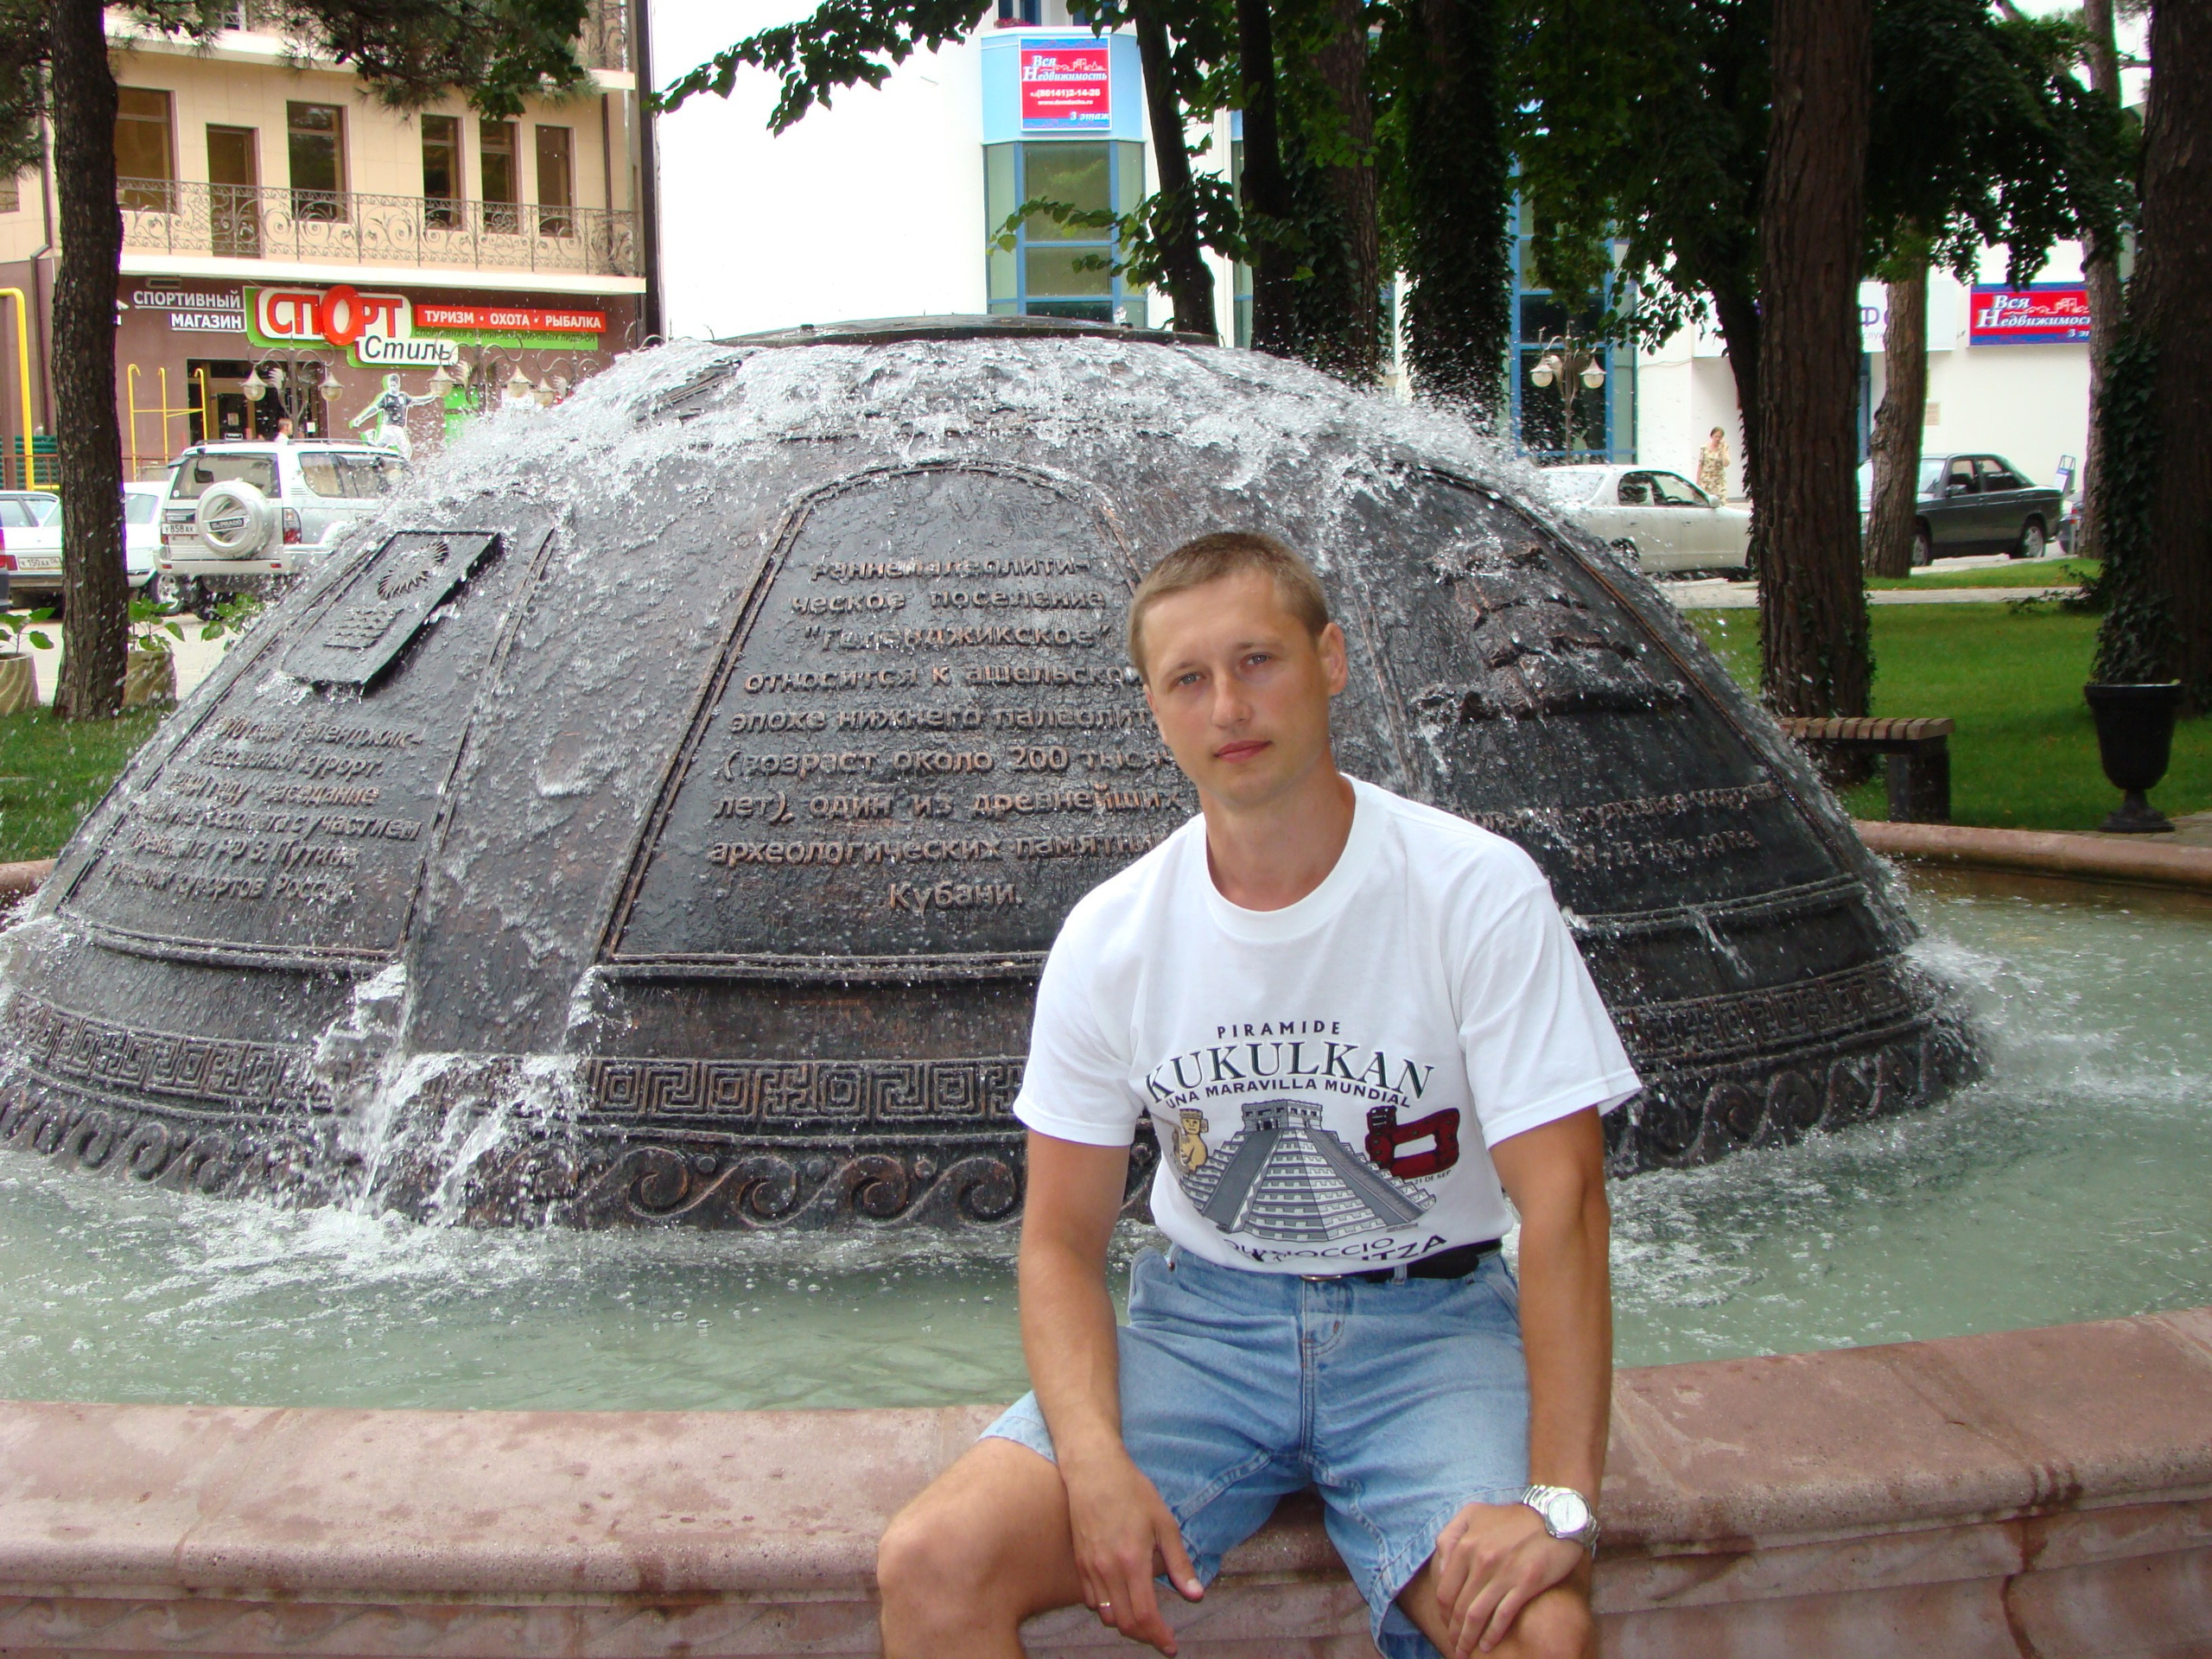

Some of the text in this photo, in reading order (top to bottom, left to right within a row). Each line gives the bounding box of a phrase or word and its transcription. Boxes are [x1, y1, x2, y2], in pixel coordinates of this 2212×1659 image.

[1032, 54, 1057, 67] Вся
[1022, 66, 1108, 81] Недвижимость
[1070, 111, 1109, 121] 3 этаж
[133, 289, 240, 308] СПОРТИВНЫЙ
[1993, 295, 2031, 309] Вся
[171, 313, 242, 329] МАГАЗИН
[266, 284, 404, 346] СПОРТ
[424, 309, 602, 328] ТУРИЗМ ОХОТА РЫБАЛКА
[2068, 328, 2076, 339] 3
[365, 335, 453, 360] Стиль
[810, 557, 1090, 582] раннепалеолити-
[790, 589, 1108, 615] ческое поселение
[745, 669, 918, 693] относится
[932, 665, 950, 685] к
[730, 709, 828, 733] эпохе
[836, 707, 984, 732] нижнего
[722, 750, 879, 779] (возраст
[893, 750, 995, 773] около
[1011, 746, 1071, 772] 200
[261, 785, 379, 806] заседание
[809, 793, 893, 822] один
[912, 792, 951, 817] из
[970, 783, 1182, 817] древнейших
[304, 815, 423, 841] участием
[709, 836, 1003, 868] археологических
[1217, 1020, 1341, 1039] PIRAMIDE
[1146, 1040, 1436, 1104] KUKULKAN
[1166, 1077, 1412, 1110] UNA MARAVILLA MUNDIAL
[1436, 1169, 1452, 1179] SEP
